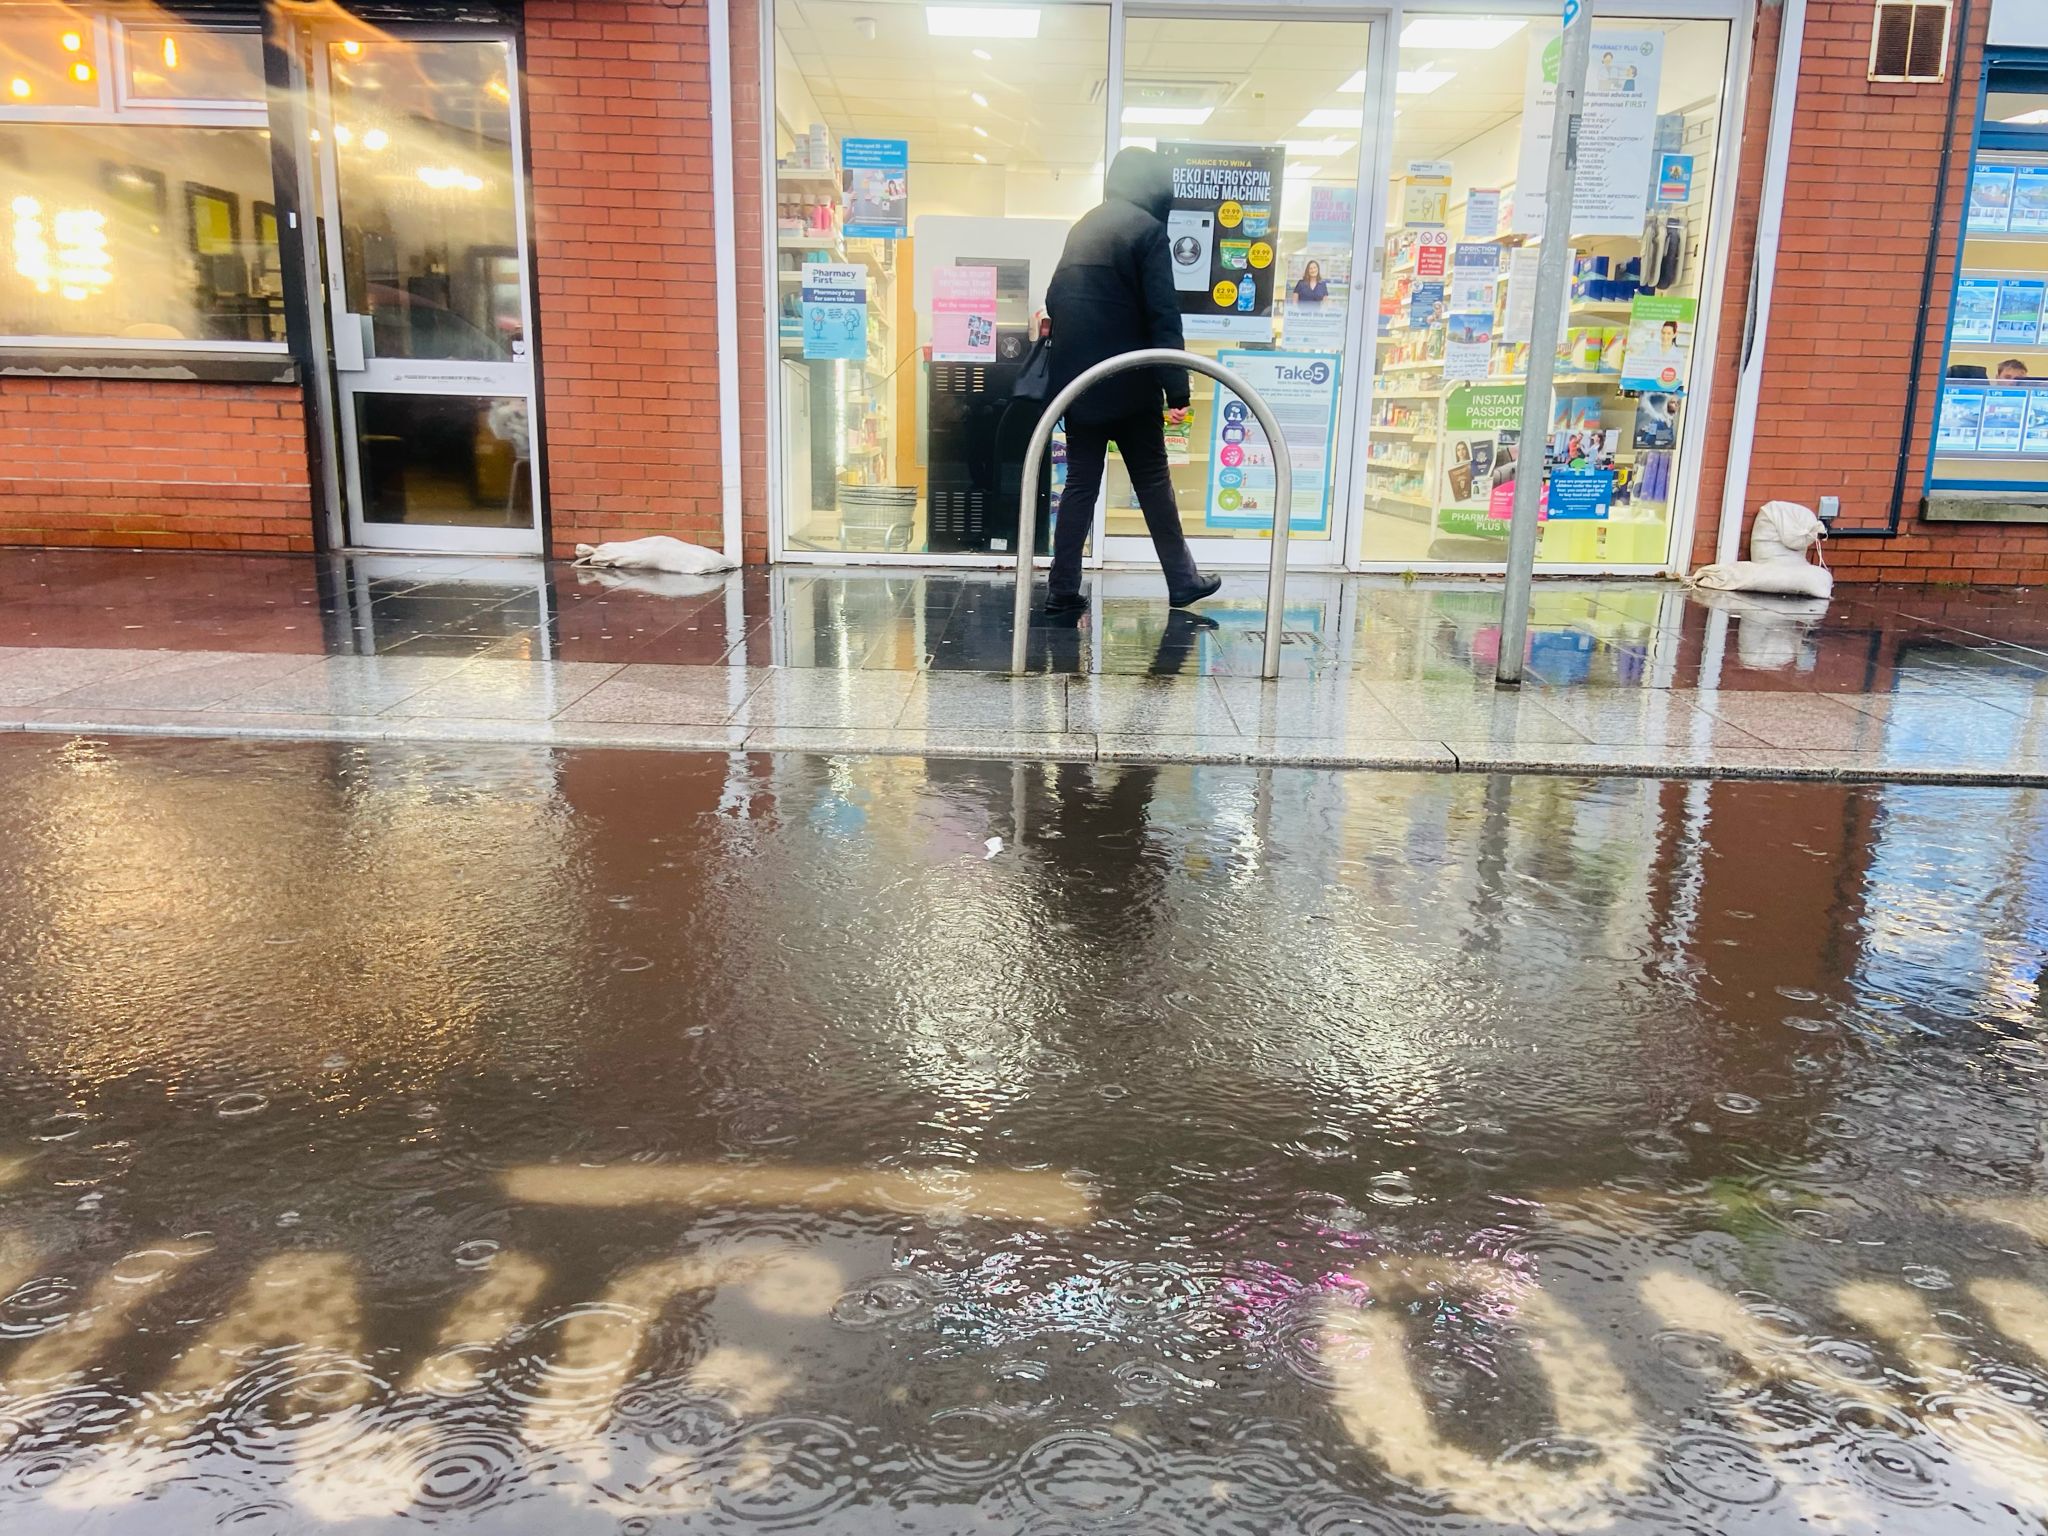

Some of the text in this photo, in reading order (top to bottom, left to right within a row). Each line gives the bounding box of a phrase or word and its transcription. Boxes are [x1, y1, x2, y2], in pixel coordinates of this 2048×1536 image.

[1186, 158, 1217, 166] CHANCE
[1246, 160, 1252, 168] A
[1172, 168, 1271, 187] BEKO ENERGYSPIN
[1222, 185, 1271, 202] MACHINE
[813, 269, 856, 279] Pharmacy
[1472, 395, 1522, 405] INSTANT
[1466, 406, 1524, 417] PASSPORT
[1472, 418, 1519, 429] PHOTOS
[1166, 437, 1187, 445] ARIEL
[1452, 512, 1498, 522] PHARMA
[1476, 523, 1500, 531] PLUS
